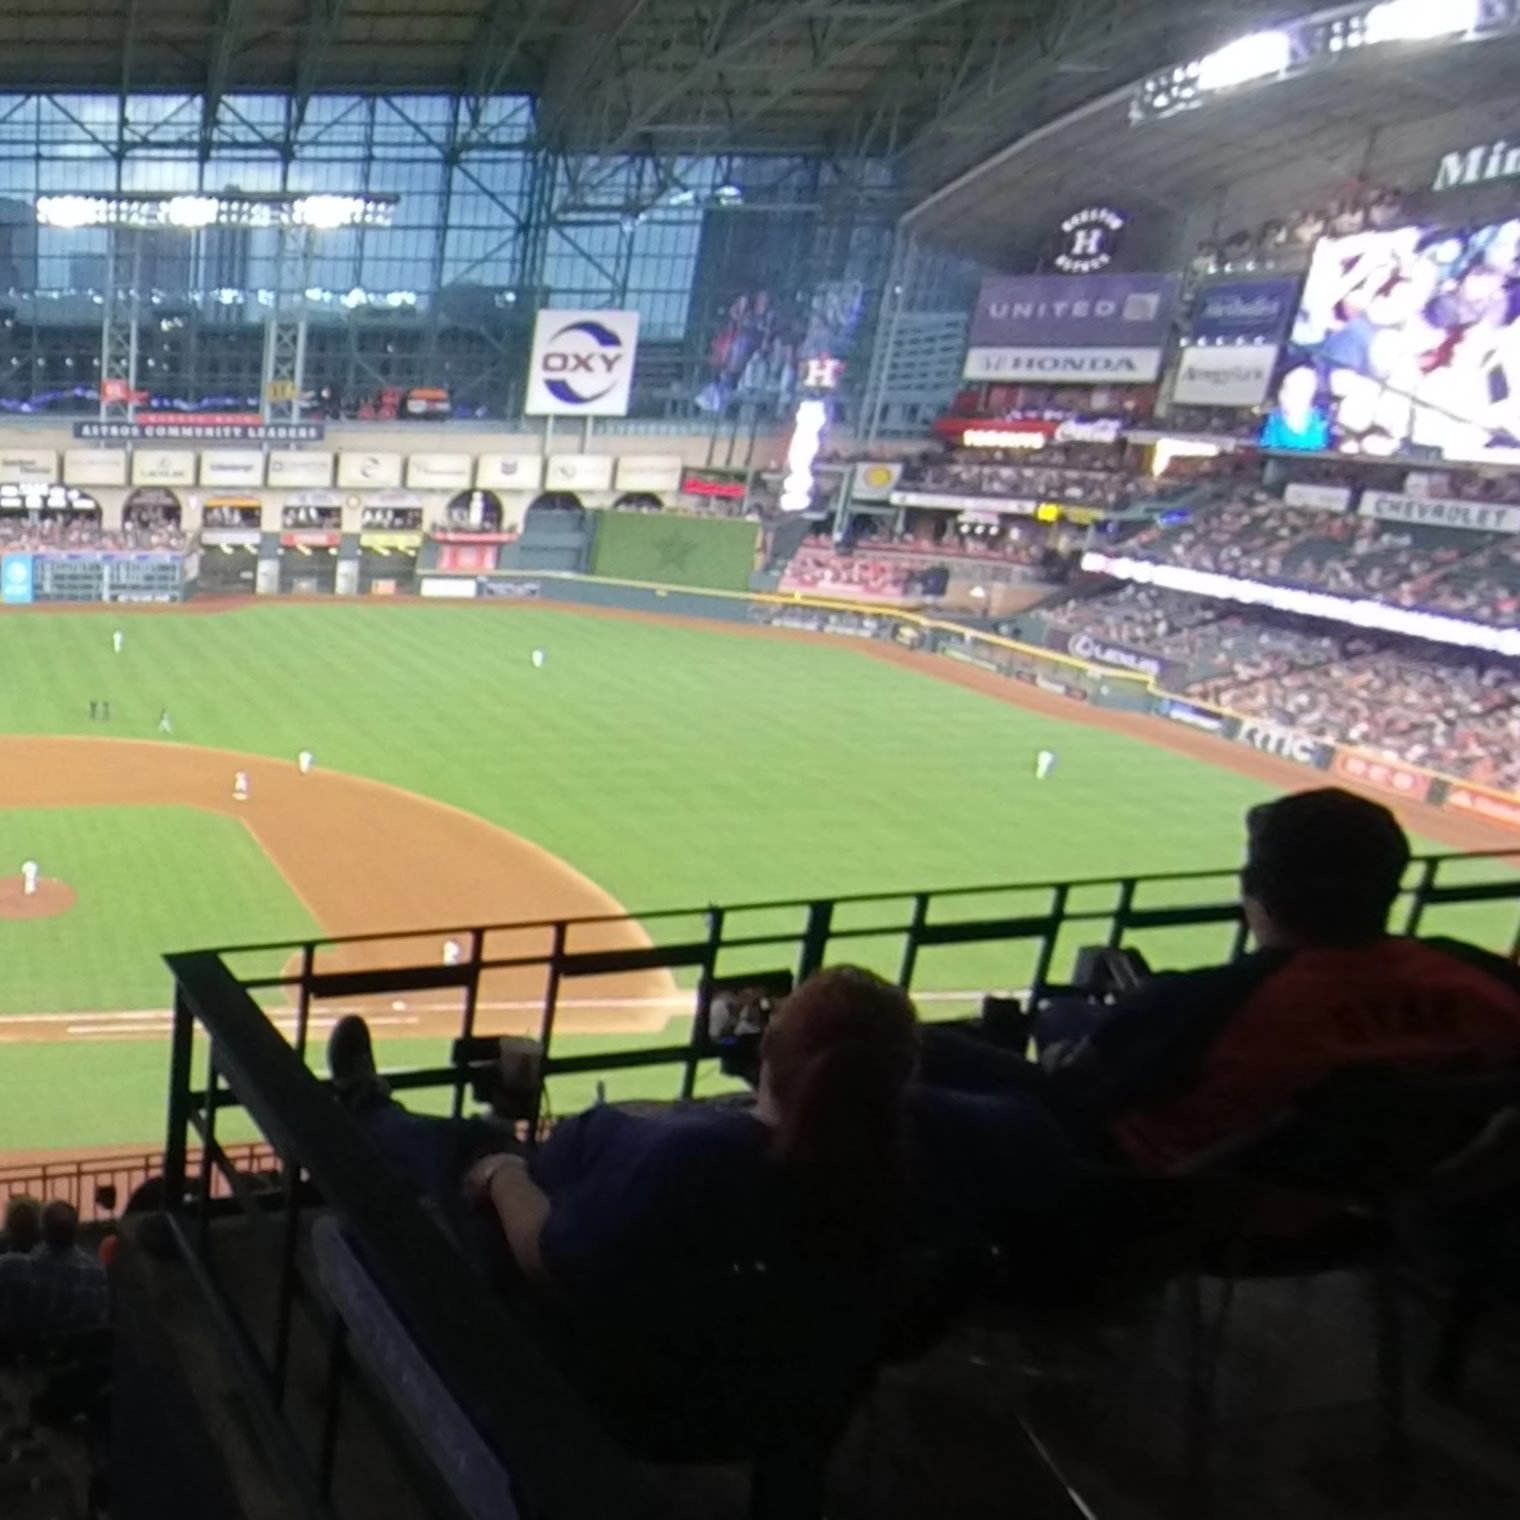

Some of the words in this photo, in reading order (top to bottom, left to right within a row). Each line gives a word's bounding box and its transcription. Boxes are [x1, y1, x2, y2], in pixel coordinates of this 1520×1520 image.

[1071, 229, 1102, 255] H
[989, 300, 1116, 320] UNITED
[541, 352, 623, 373] OXY
[1011, 356, 1137, 372] HONDA
[81, 424, 140, 438] ASTROS
[144, 424, 243, 438] COMMUNITY
[247, 425, 318, 439] LEADERS
[1374, 499, 1508, 527] CHEVROLET
